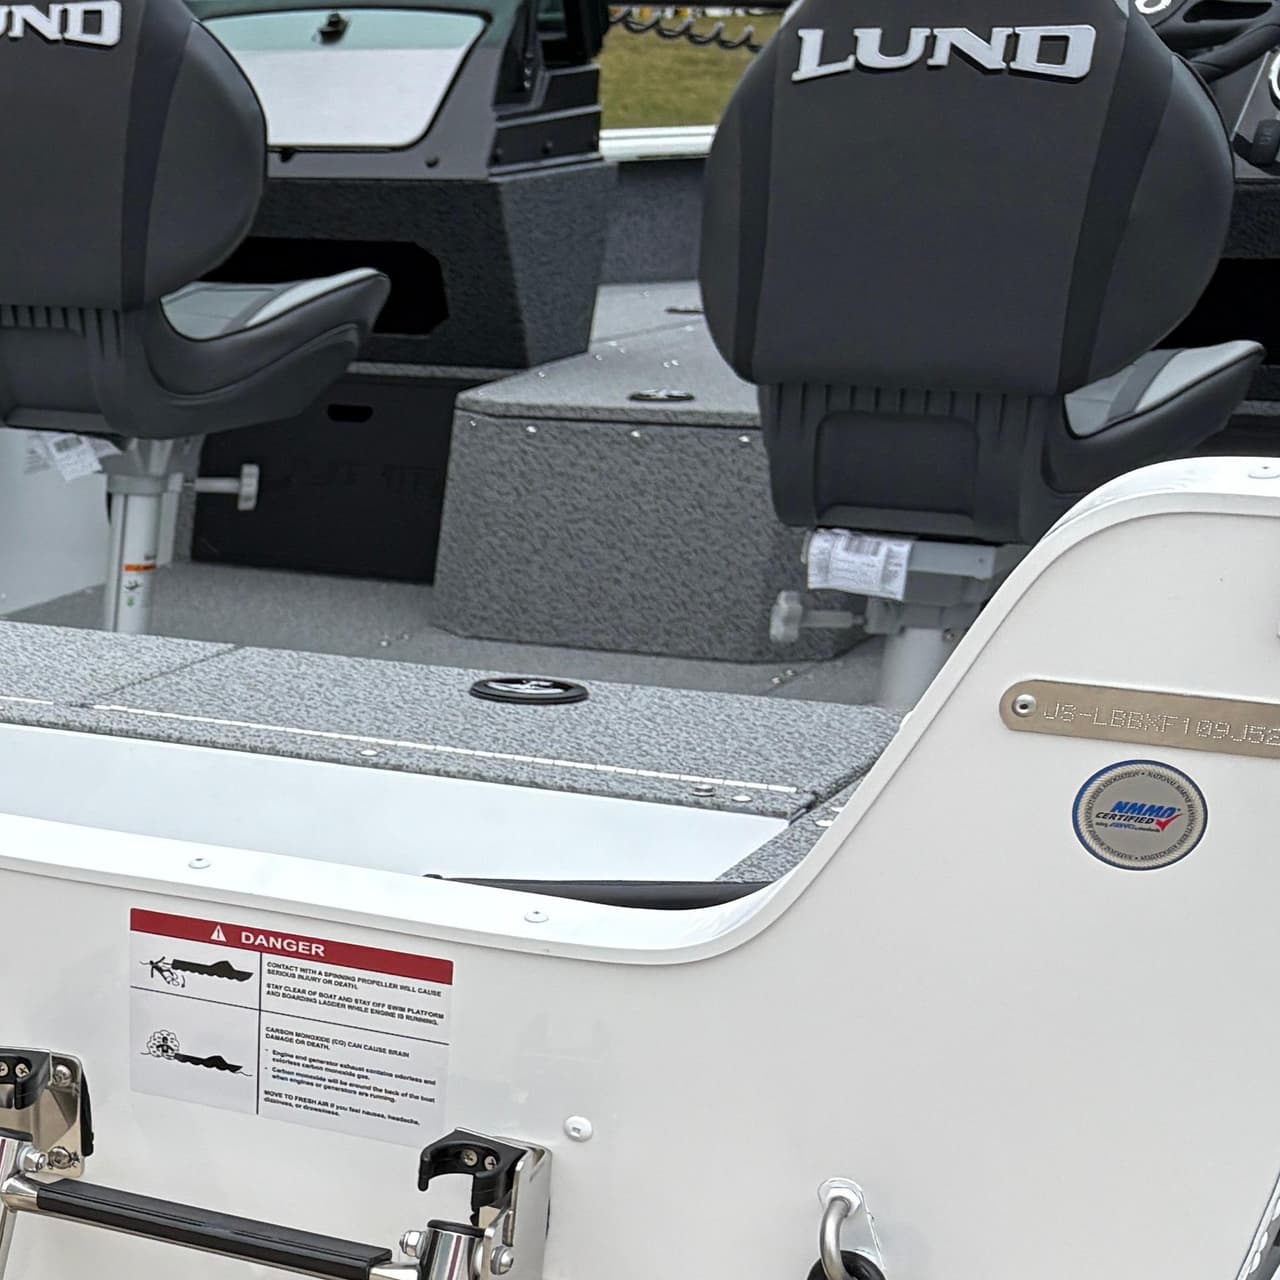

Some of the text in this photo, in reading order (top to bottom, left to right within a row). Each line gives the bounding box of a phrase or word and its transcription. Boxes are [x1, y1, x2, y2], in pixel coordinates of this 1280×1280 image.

[791, 24, 1097, 82] LUND
[1095, 811, 1155, 825] CERTIFIED
[241, 931, 325, 957] DANGER
